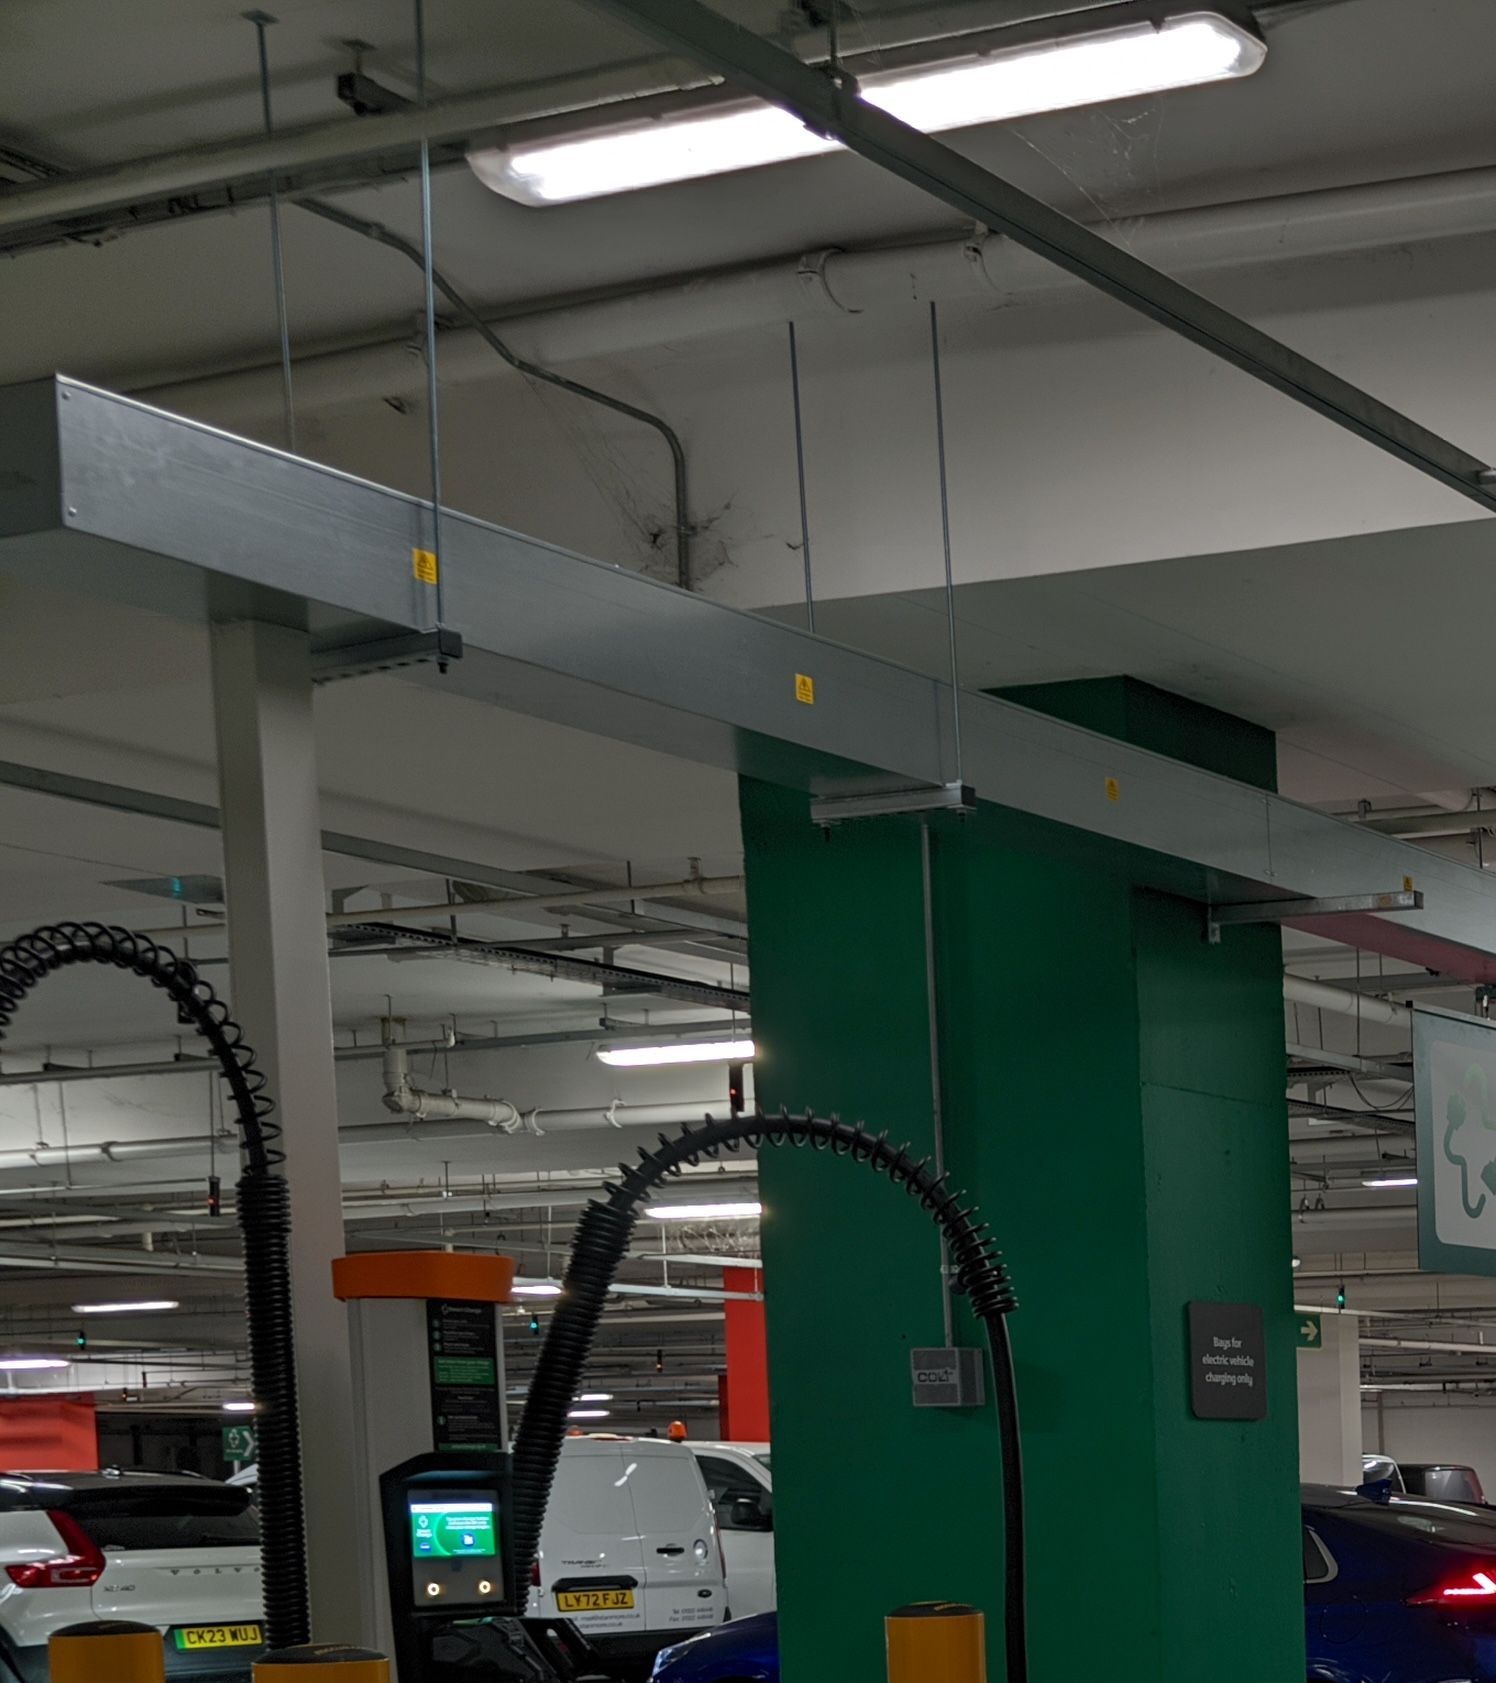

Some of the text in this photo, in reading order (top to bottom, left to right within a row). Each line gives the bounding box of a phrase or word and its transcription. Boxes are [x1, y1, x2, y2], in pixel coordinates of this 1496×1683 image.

[1213, 1336, 1243, 1350] Bays for
[1202, 1353, 1255, 1368] electric vehicle
[1205, 1371, 1254, 1387] charging only
[171, 1566, 261, 1576] VOLVO
[563, 1591, 628, 1608] LY72 FJZ
[186, 1626, 259, 1645] CK23 WUJ
